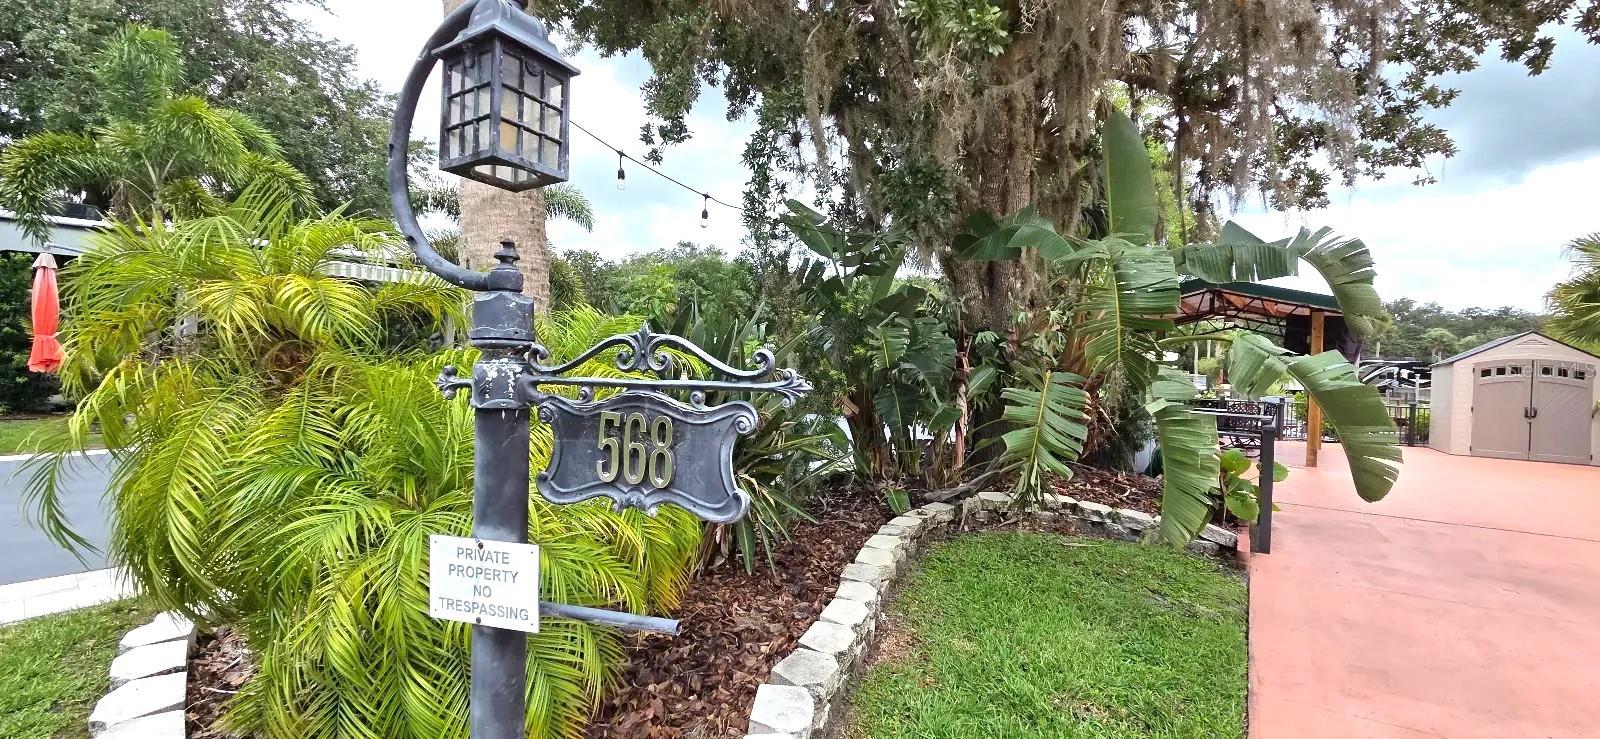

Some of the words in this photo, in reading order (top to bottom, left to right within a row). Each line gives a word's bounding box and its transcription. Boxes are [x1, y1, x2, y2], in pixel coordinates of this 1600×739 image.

[597, 411, 674, 488] 568
[457, 547, 510, 565] PRIVATE
[448, 563, 519, 584] PROPERTY
[473, 584, 492, 598] NO
[438, 597, 529, 621] TRESPASSING
